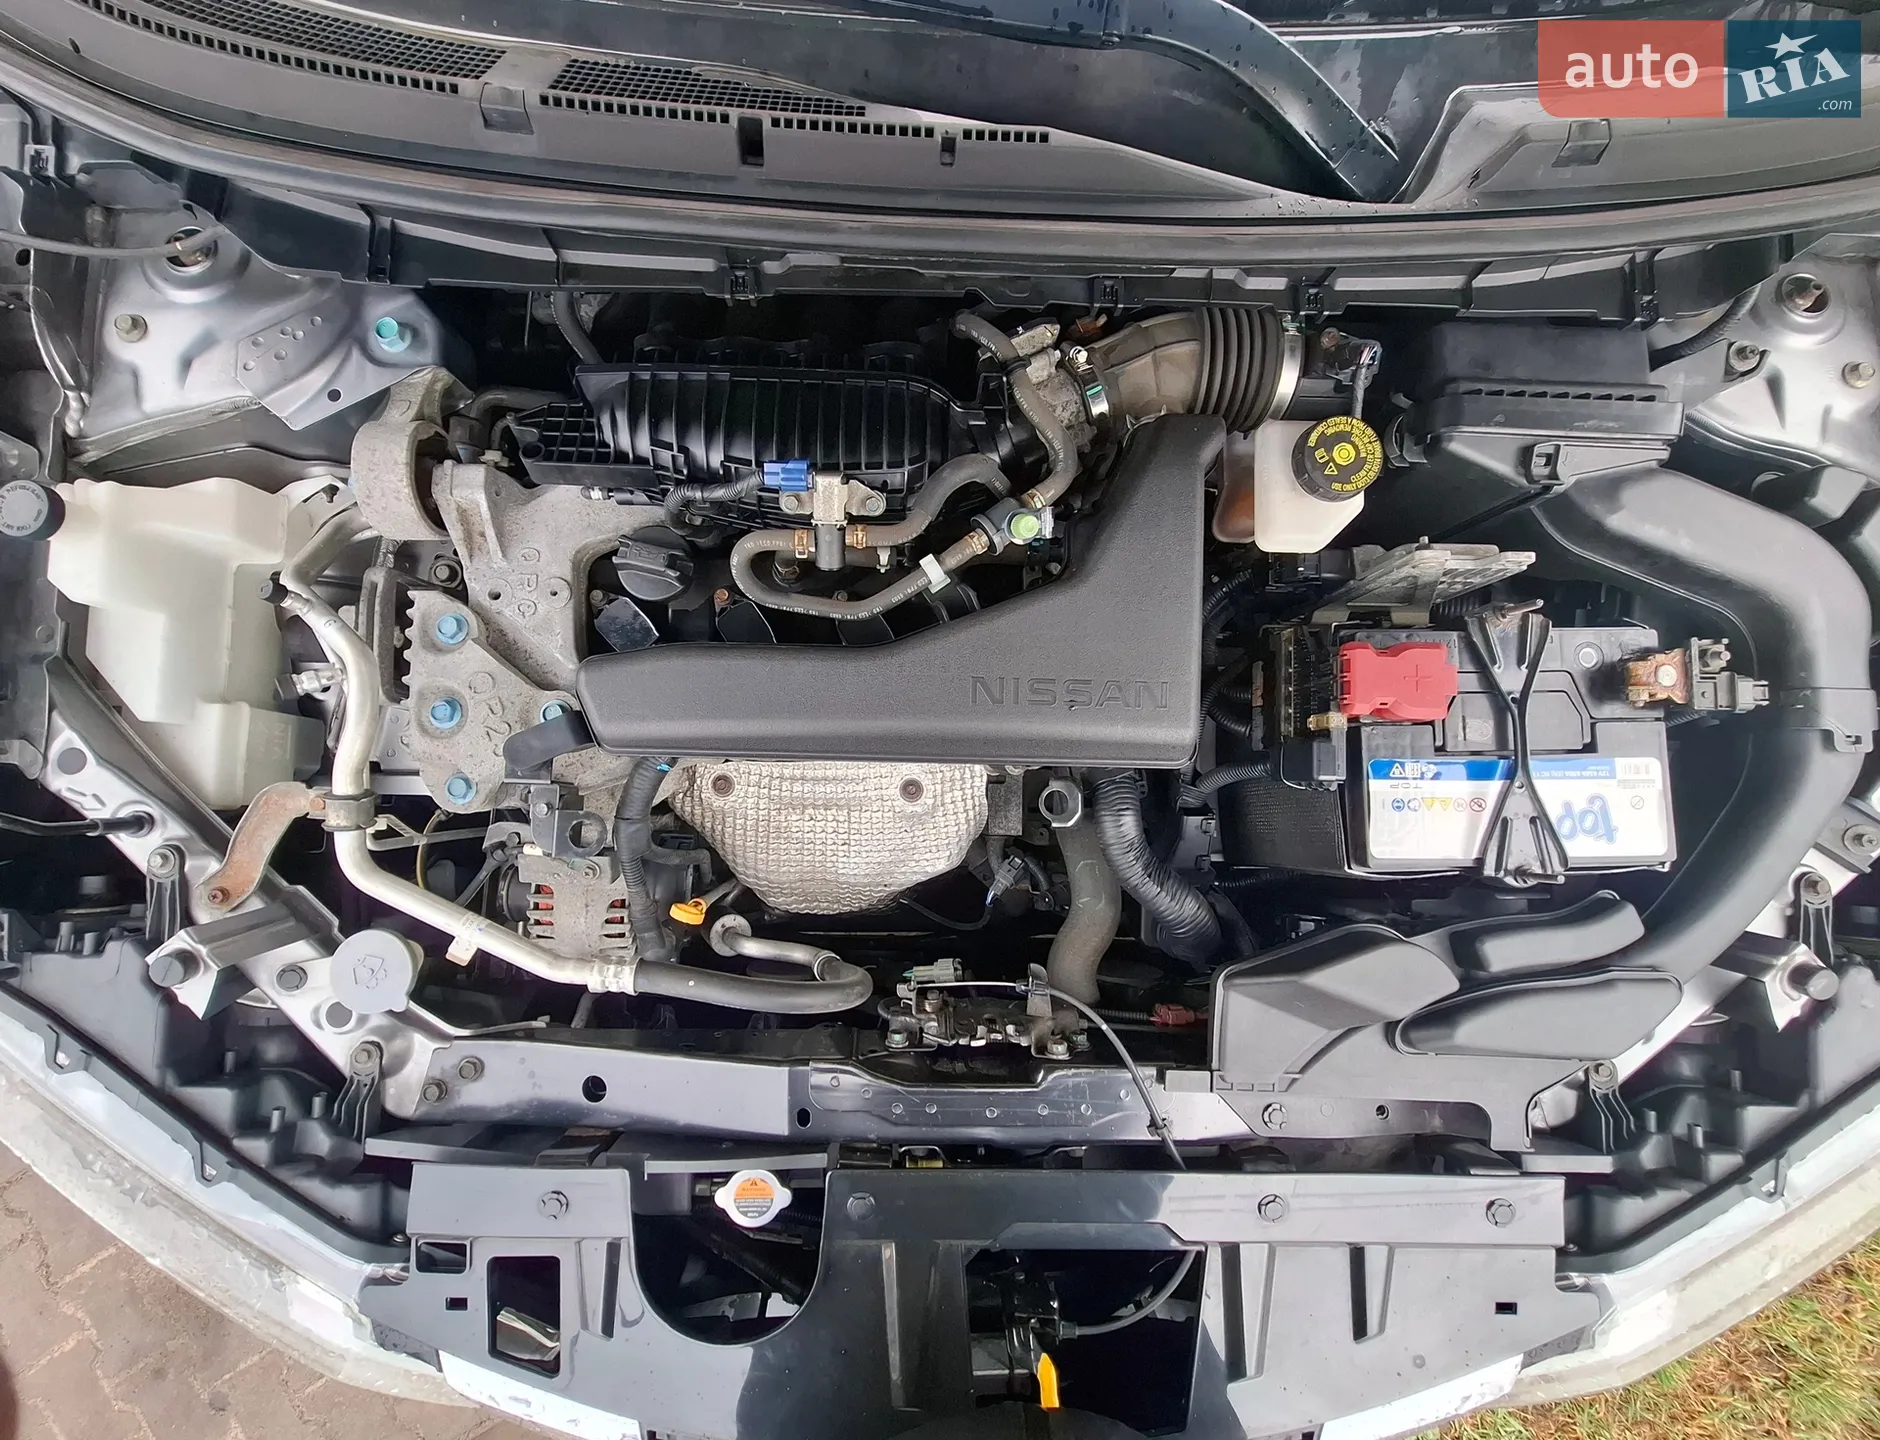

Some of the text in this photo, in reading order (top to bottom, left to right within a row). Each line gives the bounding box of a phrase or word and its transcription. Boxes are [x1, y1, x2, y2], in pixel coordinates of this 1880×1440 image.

[1366, 443, 1374, 454] CAP
[1331, 482, 1342, 491] USE
[1364, 427, 1379, 442] FLUID
[1363, 455, 1375, 471] FILLER
[1350, 470, 1367, 483] CLEAN
[970, 675, 1170, 711] NISSAN
